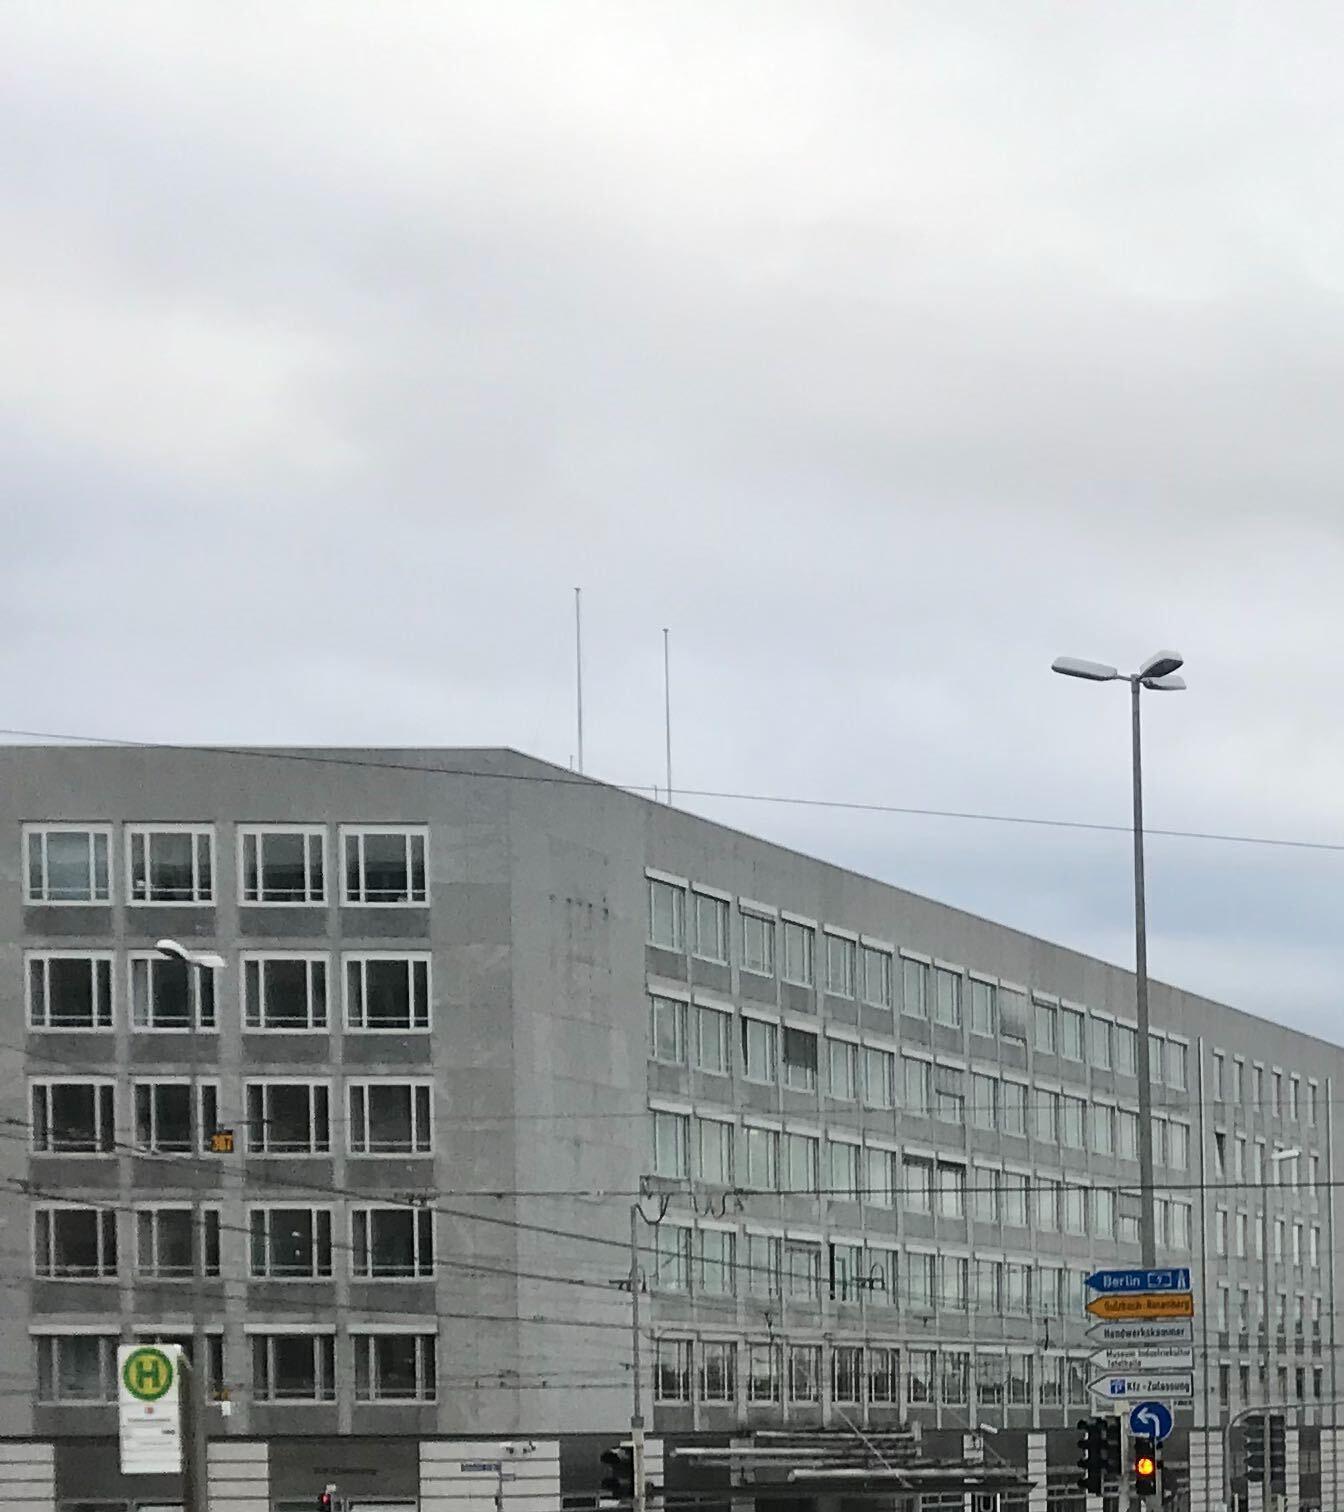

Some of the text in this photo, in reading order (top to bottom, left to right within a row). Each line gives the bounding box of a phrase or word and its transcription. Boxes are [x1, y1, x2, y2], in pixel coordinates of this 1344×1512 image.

[1103, 1275, 1140, 1288] Berlin
[1103, 1326, 1185, 1339] Handwerkskammer
[136, 1360, 160, 1389] H
